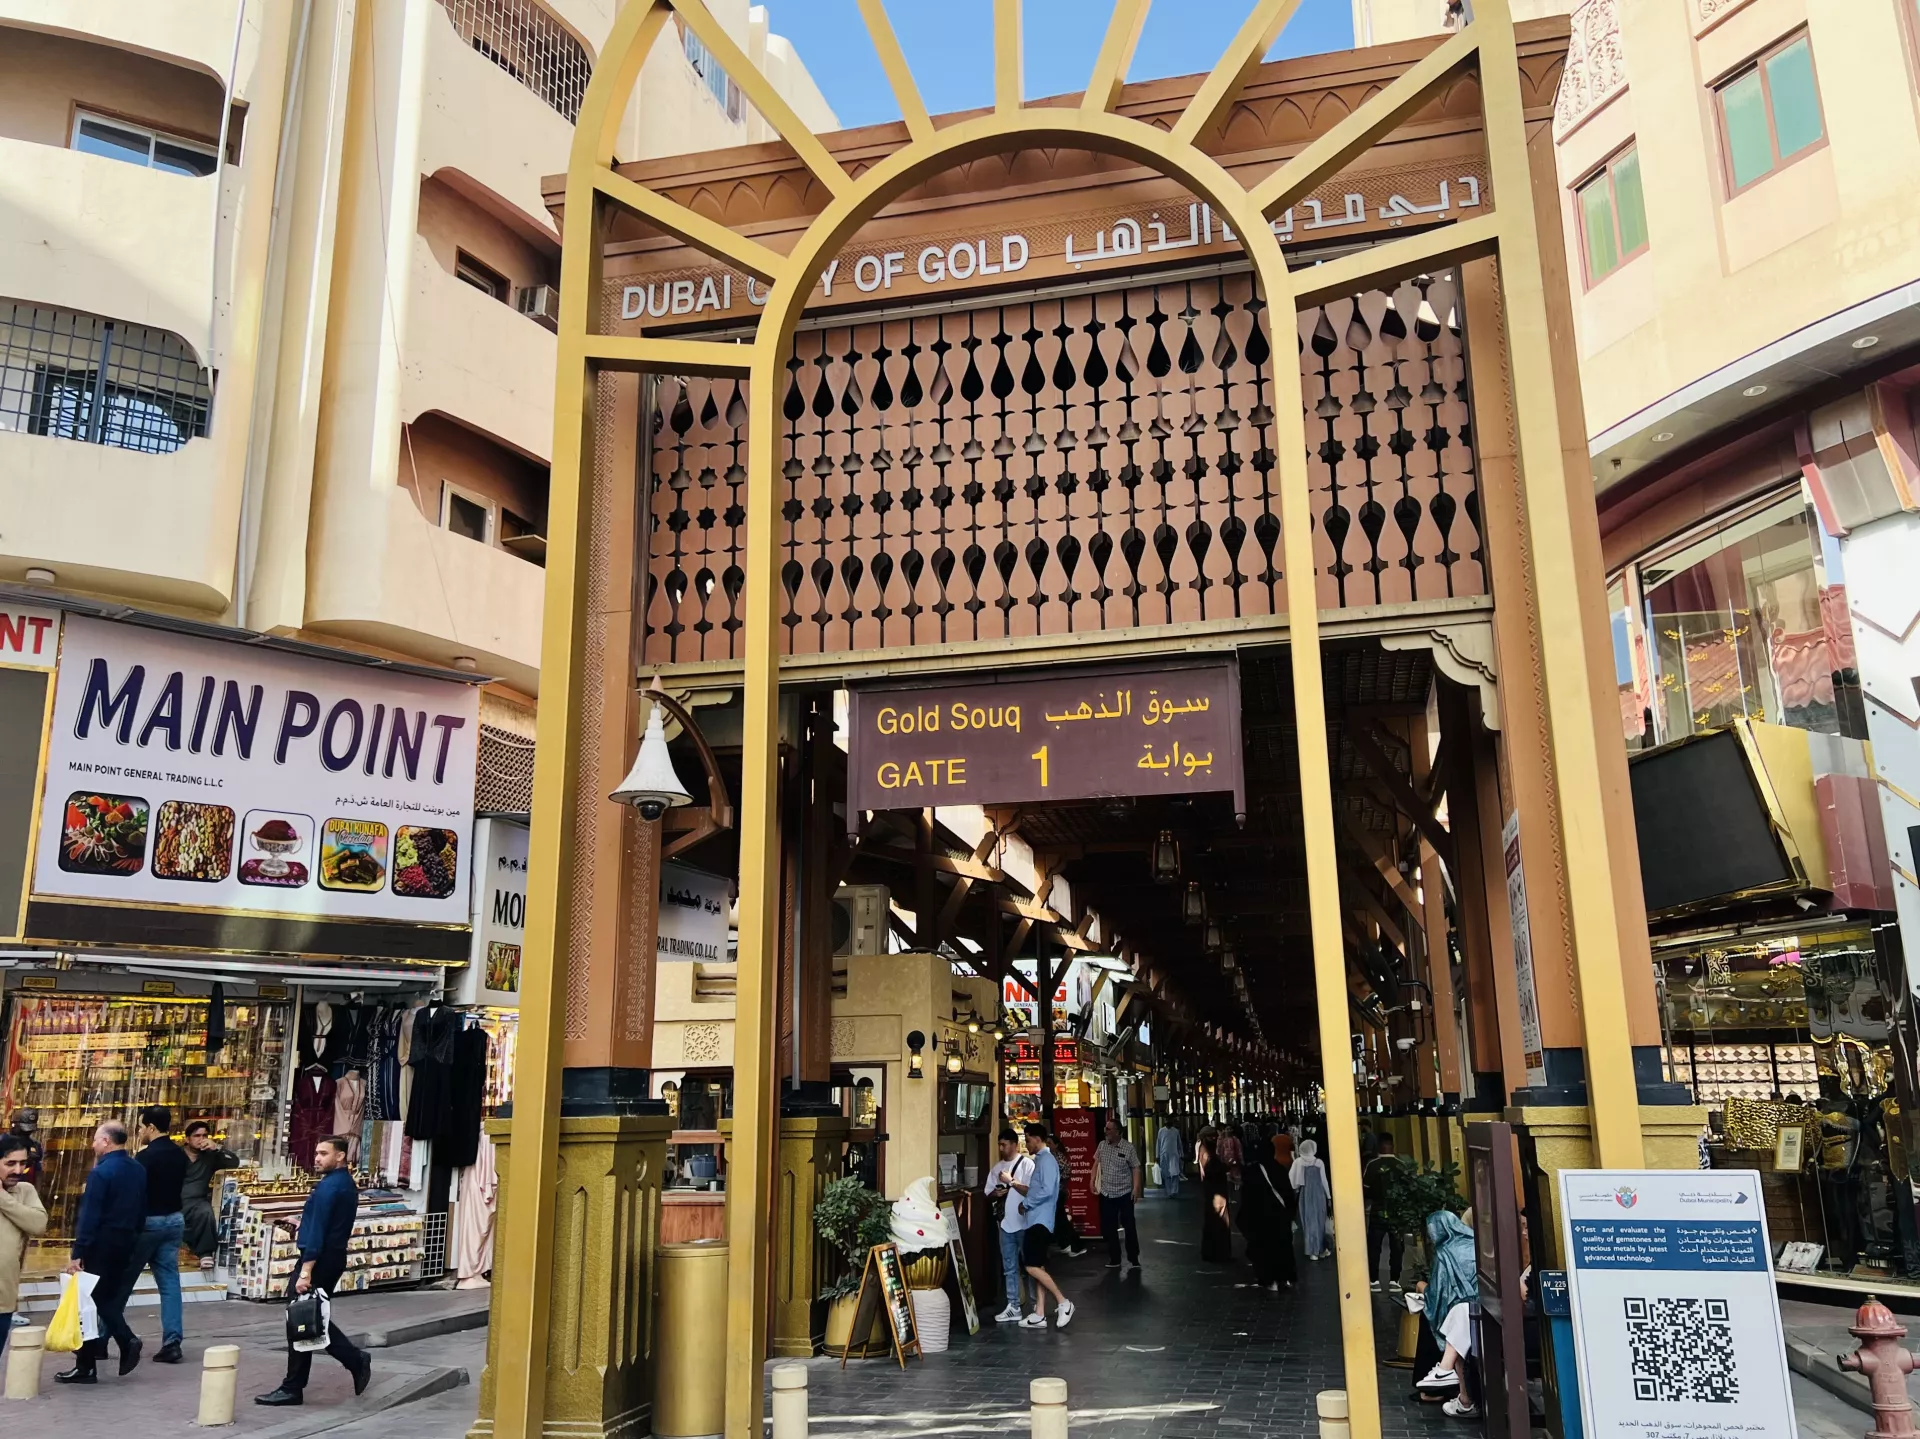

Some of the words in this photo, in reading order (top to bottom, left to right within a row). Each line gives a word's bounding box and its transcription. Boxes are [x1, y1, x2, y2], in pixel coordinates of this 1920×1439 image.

[1379, 176, 1480, 227] دبي
[1066, 203, 1211, 271] الذهب
[621, 274, 731, 320] DUBAI
[747, 260, 838, 306] CY
[854, 252, 905, 292] OF
[917, 234, 1030, 285] GOLD
[73, 658, 264, 761] MAIN
[273, 689, 466, 785] POINT
[877, 705, 940, 736] Gold
[950, 703, 1022, 733] Souq
[1044, 689, 1132, 731] الذهب
[1141, 689, 1210, 727] سوق
[69, 761, 93, 773] MAIN
[94, 764, 122, 776] POINT
[123, 768, 163, 781] GENERAL
[165, 772, 202, 785] TRADING
[204, 778, 223, 788] L.L.C
[876, 758, 967, 789] GATE
[1031, 745, 1049, 788] 1
[1136, 741, 1213, 777] بوابة
[370, 796, 394, 809] العامة
[395, 800, 421, 813] للتجارة
[669, 938, 695, 957] TRADING
[1582, 1235, 1604, 1244] quality
[1606, 1235, 1613, 1243] of
[1616, 1236, 1652, 1244] gemstones
[1637, 1245, 1646, 1253] by
[1648, 1245, 1668, 1253] latest
[1616, 1255, 1655, 1263] technology.
